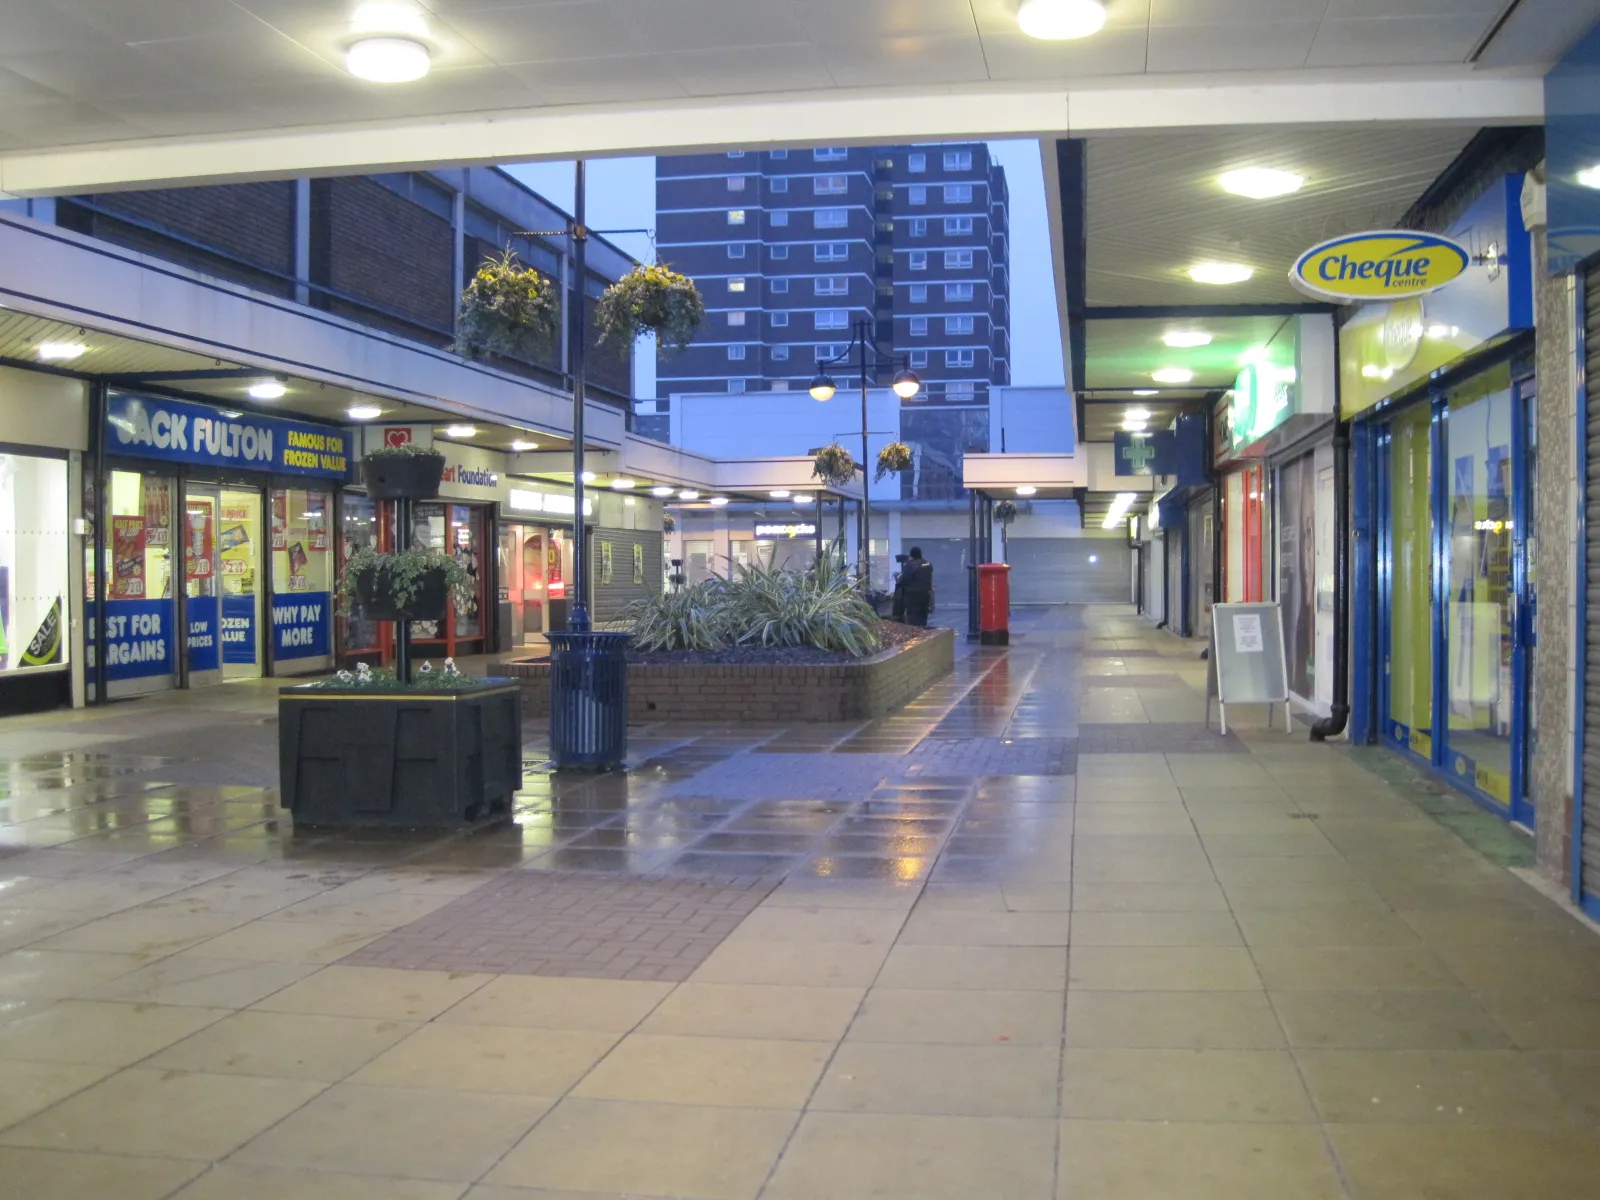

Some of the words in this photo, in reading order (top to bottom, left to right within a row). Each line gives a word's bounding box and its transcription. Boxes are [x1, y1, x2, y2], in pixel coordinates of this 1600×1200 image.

[1319, 254, 1430, 288] Cheque
[1392, 278, 1427, 288] centre
[117, 401, 188, 451] JACK
[193, 417, 273, 462] FULTON
[288, 431, 325, 449] FAMOUS
[327, 436, 343, 453] FOR
[284, 449, 318, 468] FROZEN
[321, 454, 347, 471] VALUE
[441, 466, 456, 483] art
[131, 613, 161, 636] FOR
[273, 606, 298, 625] WHY
[300, 604, 321, 622] PAY
[30, 611, 57, 655] SALE
[190, 620, 208, 633] LOW
[281, 627, 313, 647] MORE
[187, 635, 213, 648] PRICES
